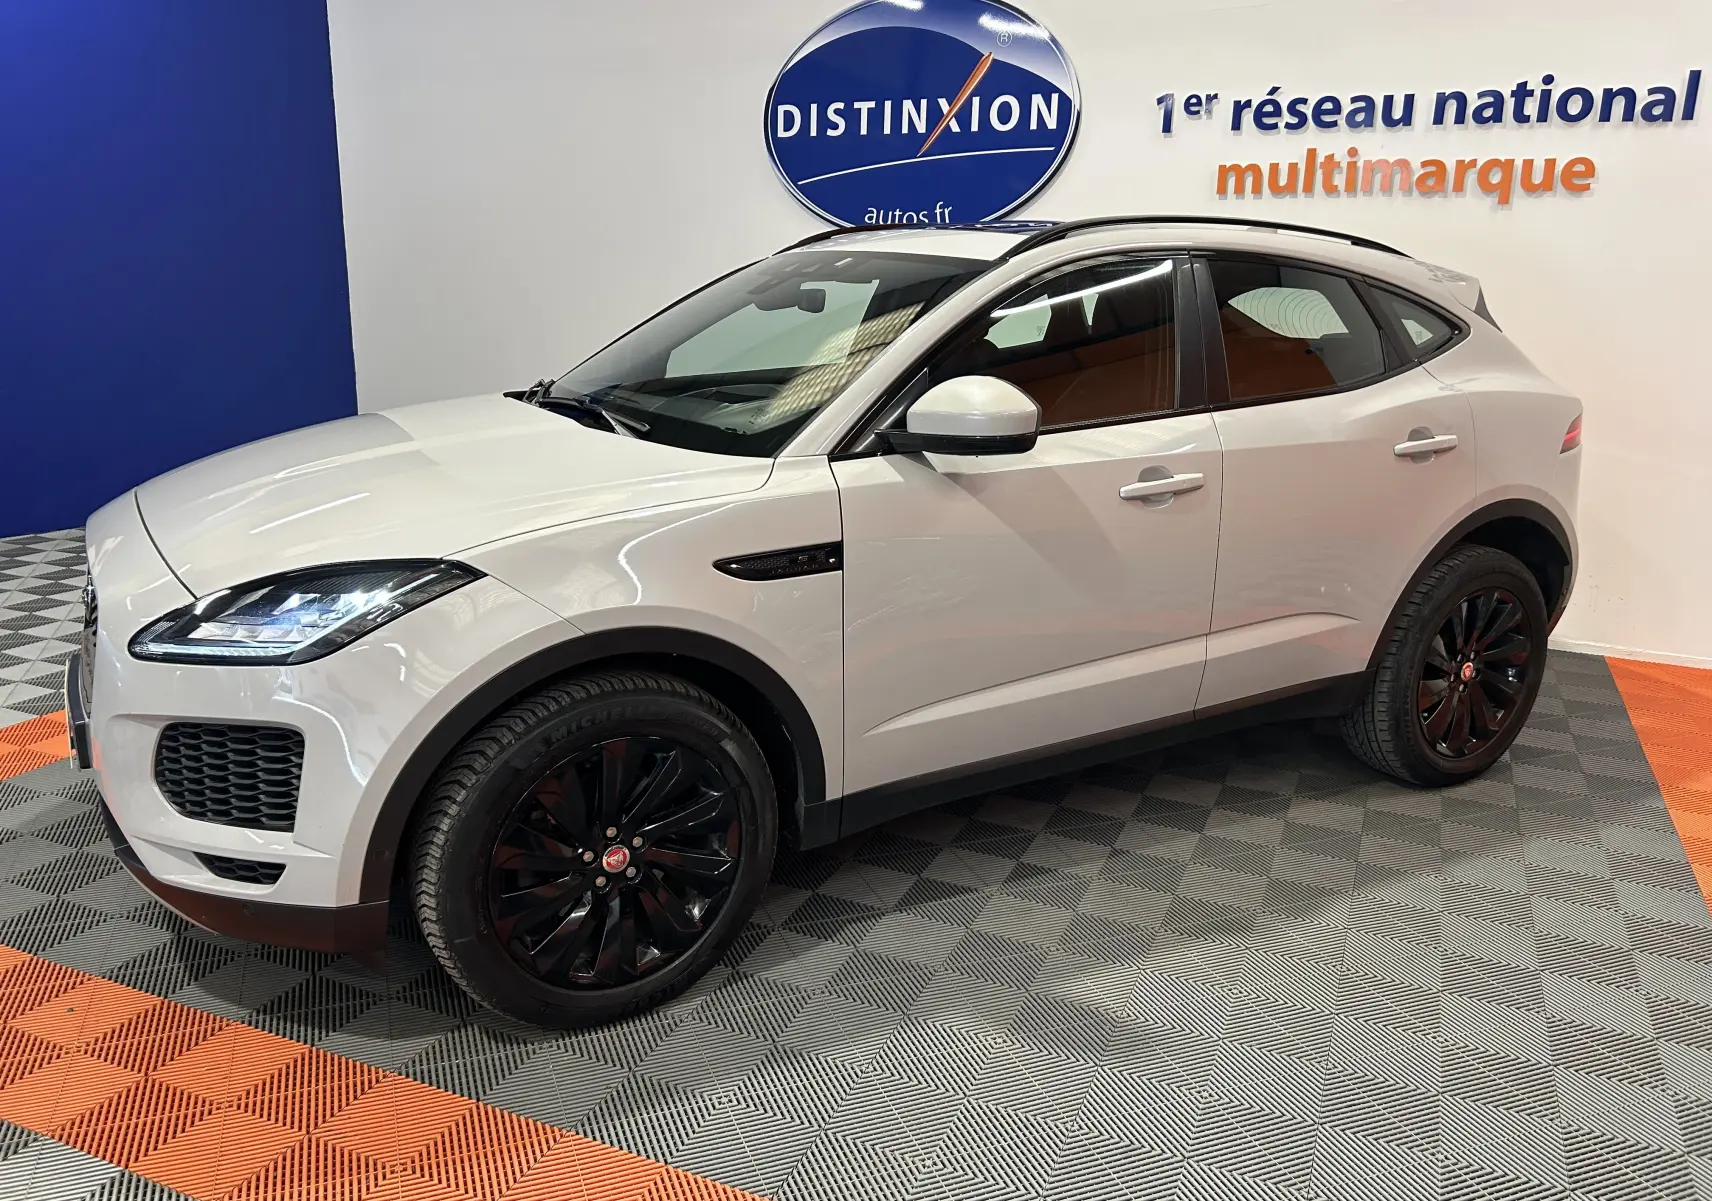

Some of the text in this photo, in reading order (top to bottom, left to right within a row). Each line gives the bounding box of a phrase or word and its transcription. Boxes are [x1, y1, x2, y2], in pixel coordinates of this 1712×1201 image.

[777, 93, 1060, 138] DISTINXION
[1156, 70, 1701, 133] 1er réseau national
[1216, 147, 1596, 204] multimarque
[550, 706, 661, 742] MICHELI
